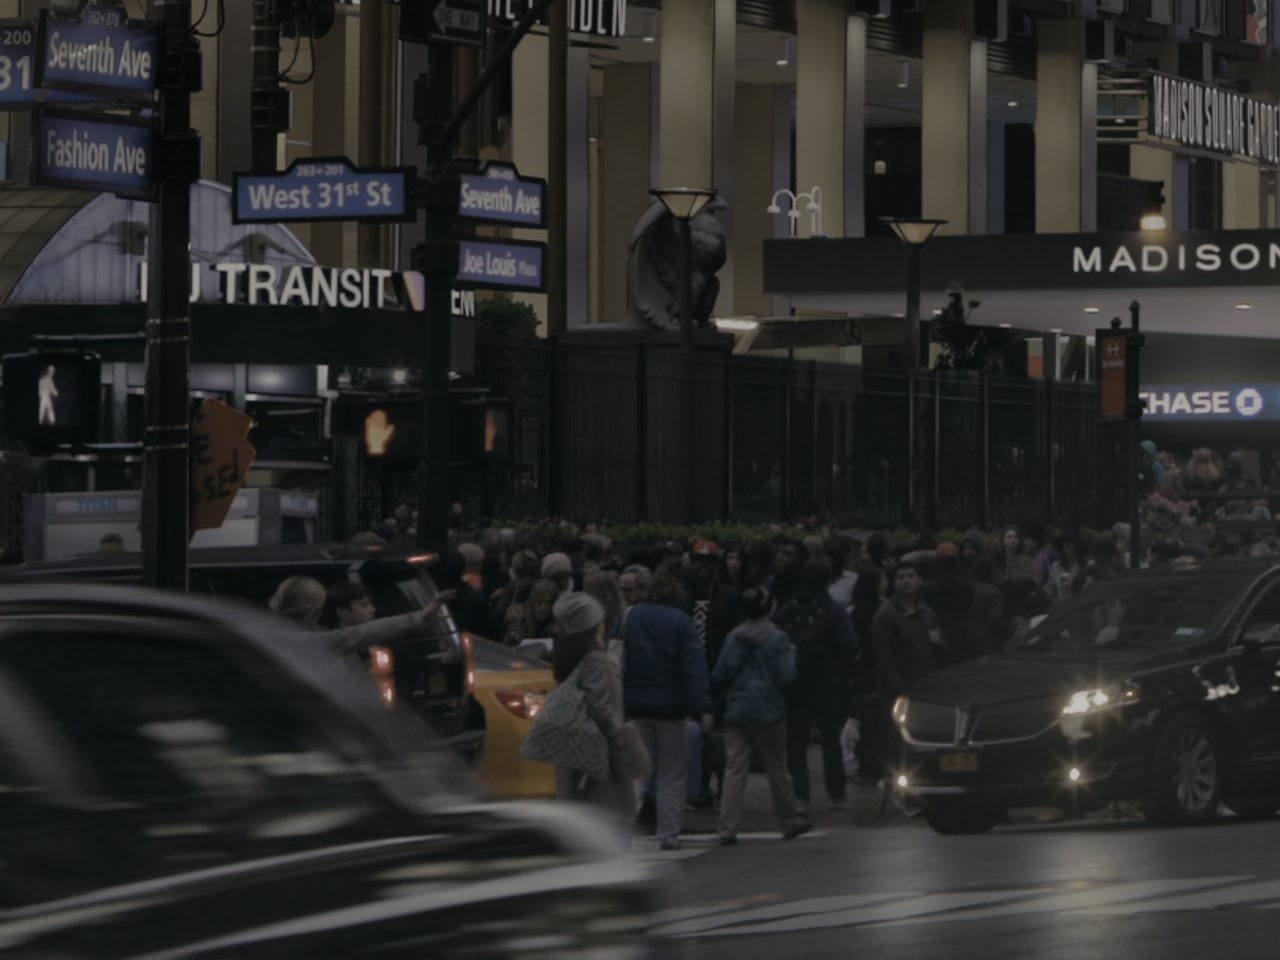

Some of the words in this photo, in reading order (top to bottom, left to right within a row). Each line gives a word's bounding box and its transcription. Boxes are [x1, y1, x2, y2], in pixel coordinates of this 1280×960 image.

[0, 55, 31, 90] 31
[48, 31, 115, 76] Seventh
[118, 40, 151, 79] Ave
[1153, 74, 1203, 146] MADISON
[47, 128, 110, 173] Fashion
[113, 136, 146, 176] Ave
[249, 182, 312, 211] West
[317, 180, 360, 208] 31st
[367, 180, 393, 208] St
[460, 181, 513, 213] Seventh
[516, 188, 541, 216] Ave
[464, 252, 485, 276] Joe
[486, 251, 518, 277] Louis
[216, 262, 392, 310] TRANSIT
